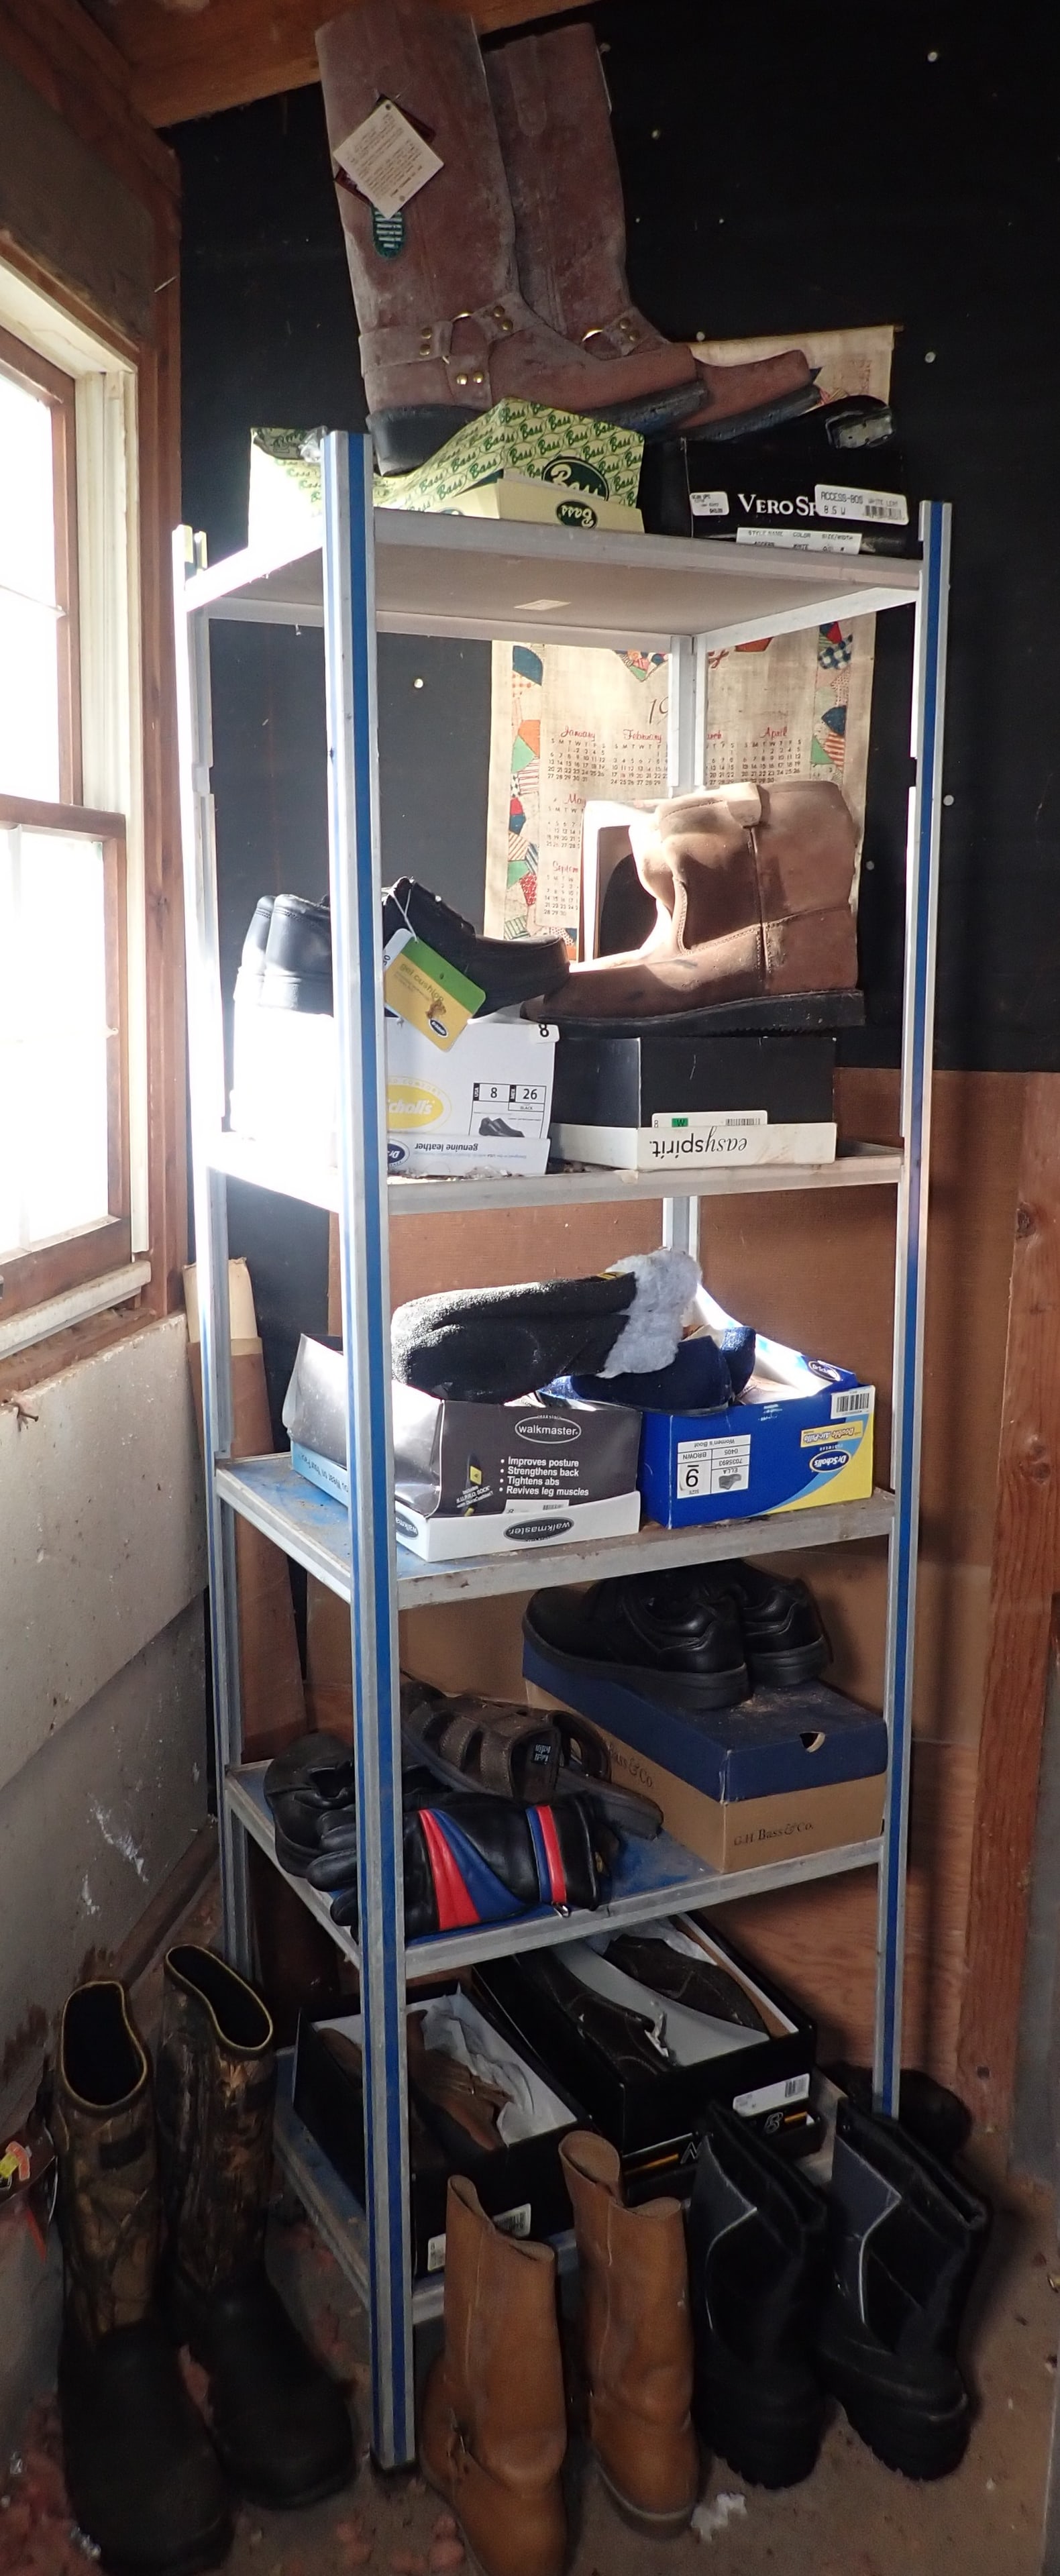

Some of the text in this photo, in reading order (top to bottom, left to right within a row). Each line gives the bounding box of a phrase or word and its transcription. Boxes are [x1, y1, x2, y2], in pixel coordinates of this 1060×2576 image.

[548, 415, 570, 430] Bass
[520, 423, 543, 439] Bass
[566, 429, 588, 446] Bass
[537, 439, 560, 455] Bass
[609, 434, 631, 452] Bass
[510, 447, 531, 464] Bass
[582, 443, 604, 460] Bass
[470, 458, 497, 479] Bass
[437, 479, 462, 500] Bass
[613, 476, 634, 490] Bass
[738, 494, 793, 514] VERO
[562, 505, 594, 527] Bass
[561, 725, 595, 741] January
[623, 729, 661, 743] February
[759, 727, 788, 740] April
[553, 861, 578, 875] Septem
[538, 1024, 549, 1037] 8
[490, 1087, 497, 1098] 8
[523, 1088, 537, 1099] 26
[415, 1142, 478, 1152] genuine leather
[508, 1456, 579, 1468] Improves posture
[683, 1452, 706, 1460] BROWN
[508, 1466, 579, 1477] Strengthens back
[507, 1476, 560, 1486] Tightens abs
[507, 1486, 589, 1497] Revives leg muscles
[758, 1829, 783, 1840] Bass
